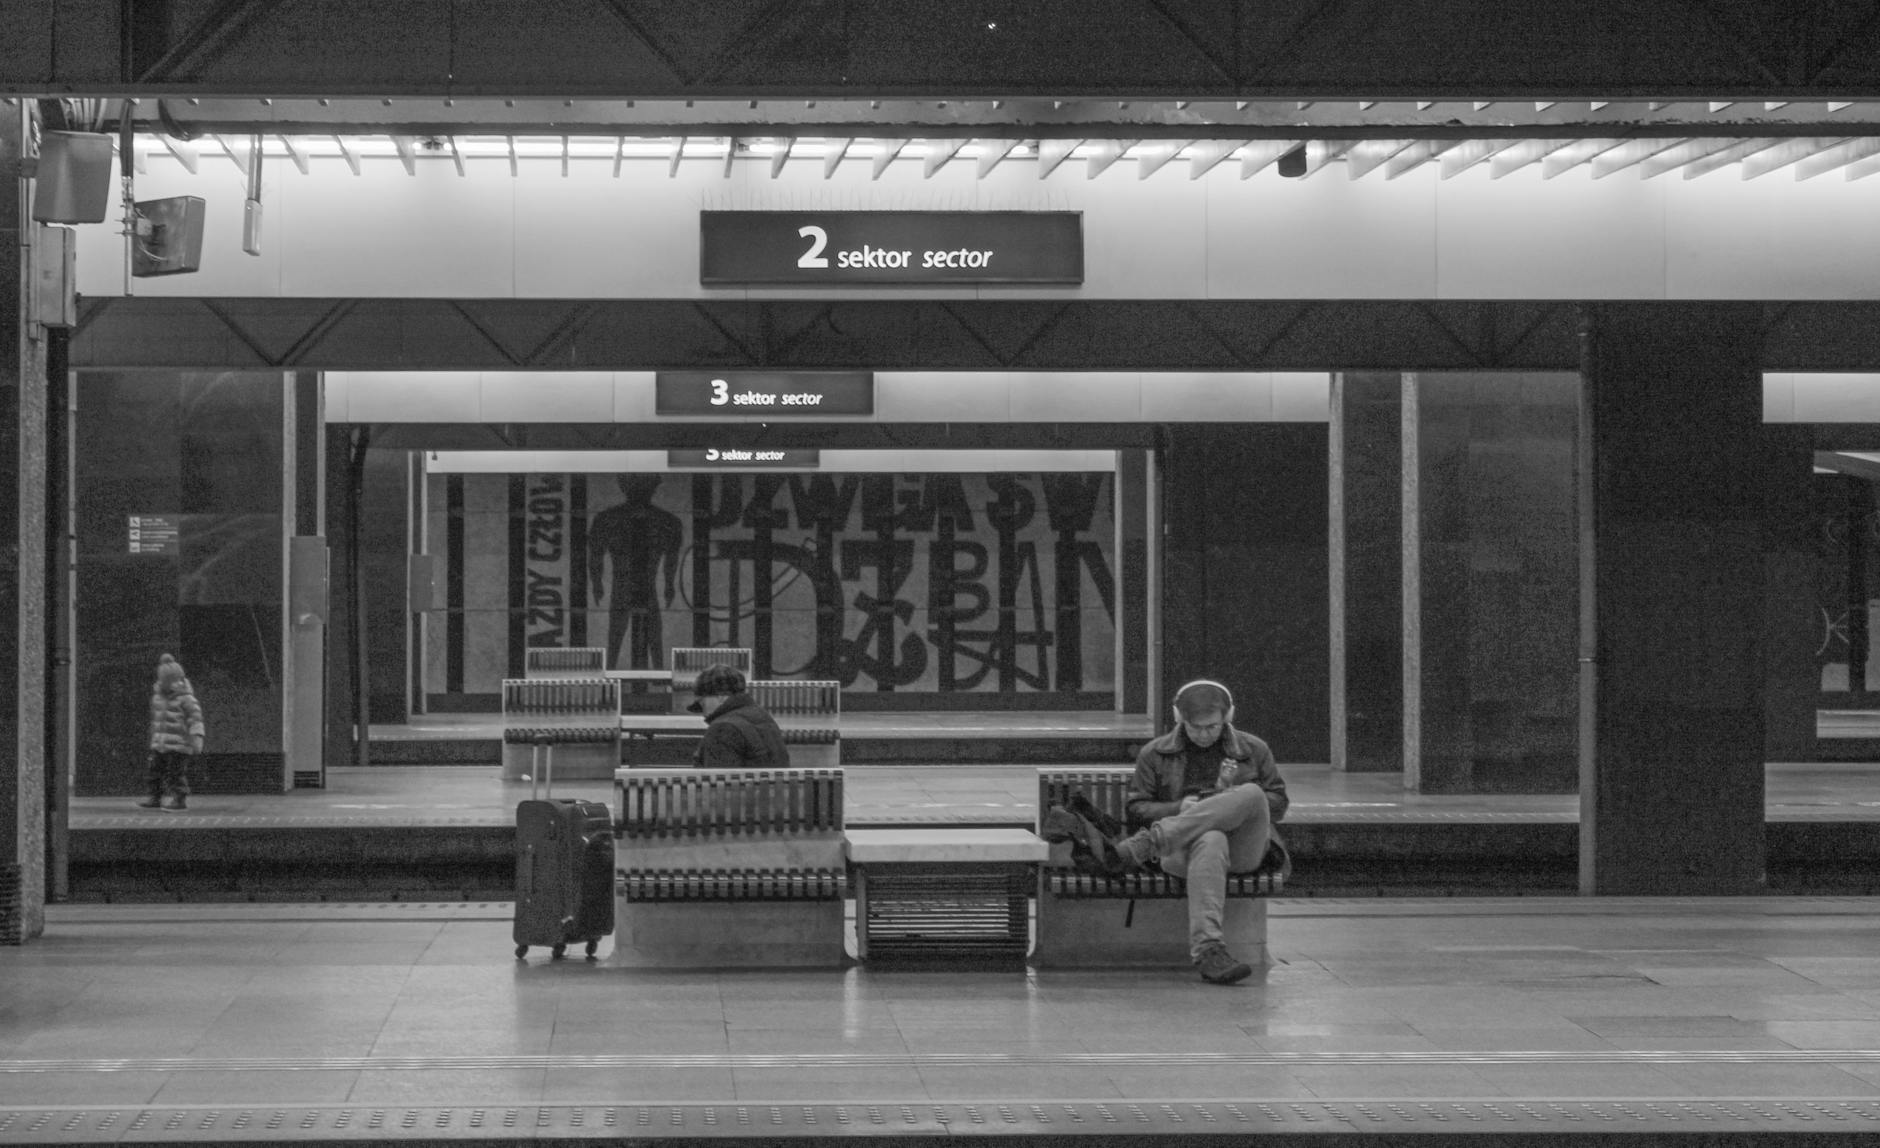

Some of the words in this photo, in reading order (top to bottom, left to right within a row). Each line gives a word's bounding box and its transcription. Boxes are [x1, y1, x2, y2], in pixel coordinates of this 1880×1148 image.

[797, 225, 829, 268] 2
[837, 244, 913, 269] sektor
[921, 247, 994, 269] sector
[710, 378, 730, 406] 3
[732, 390, 777, 406] sektor
[780, 392, 824, 406] sector
[721, 448, 754, 461] sektor
[754, 449, 786, 461] sector
